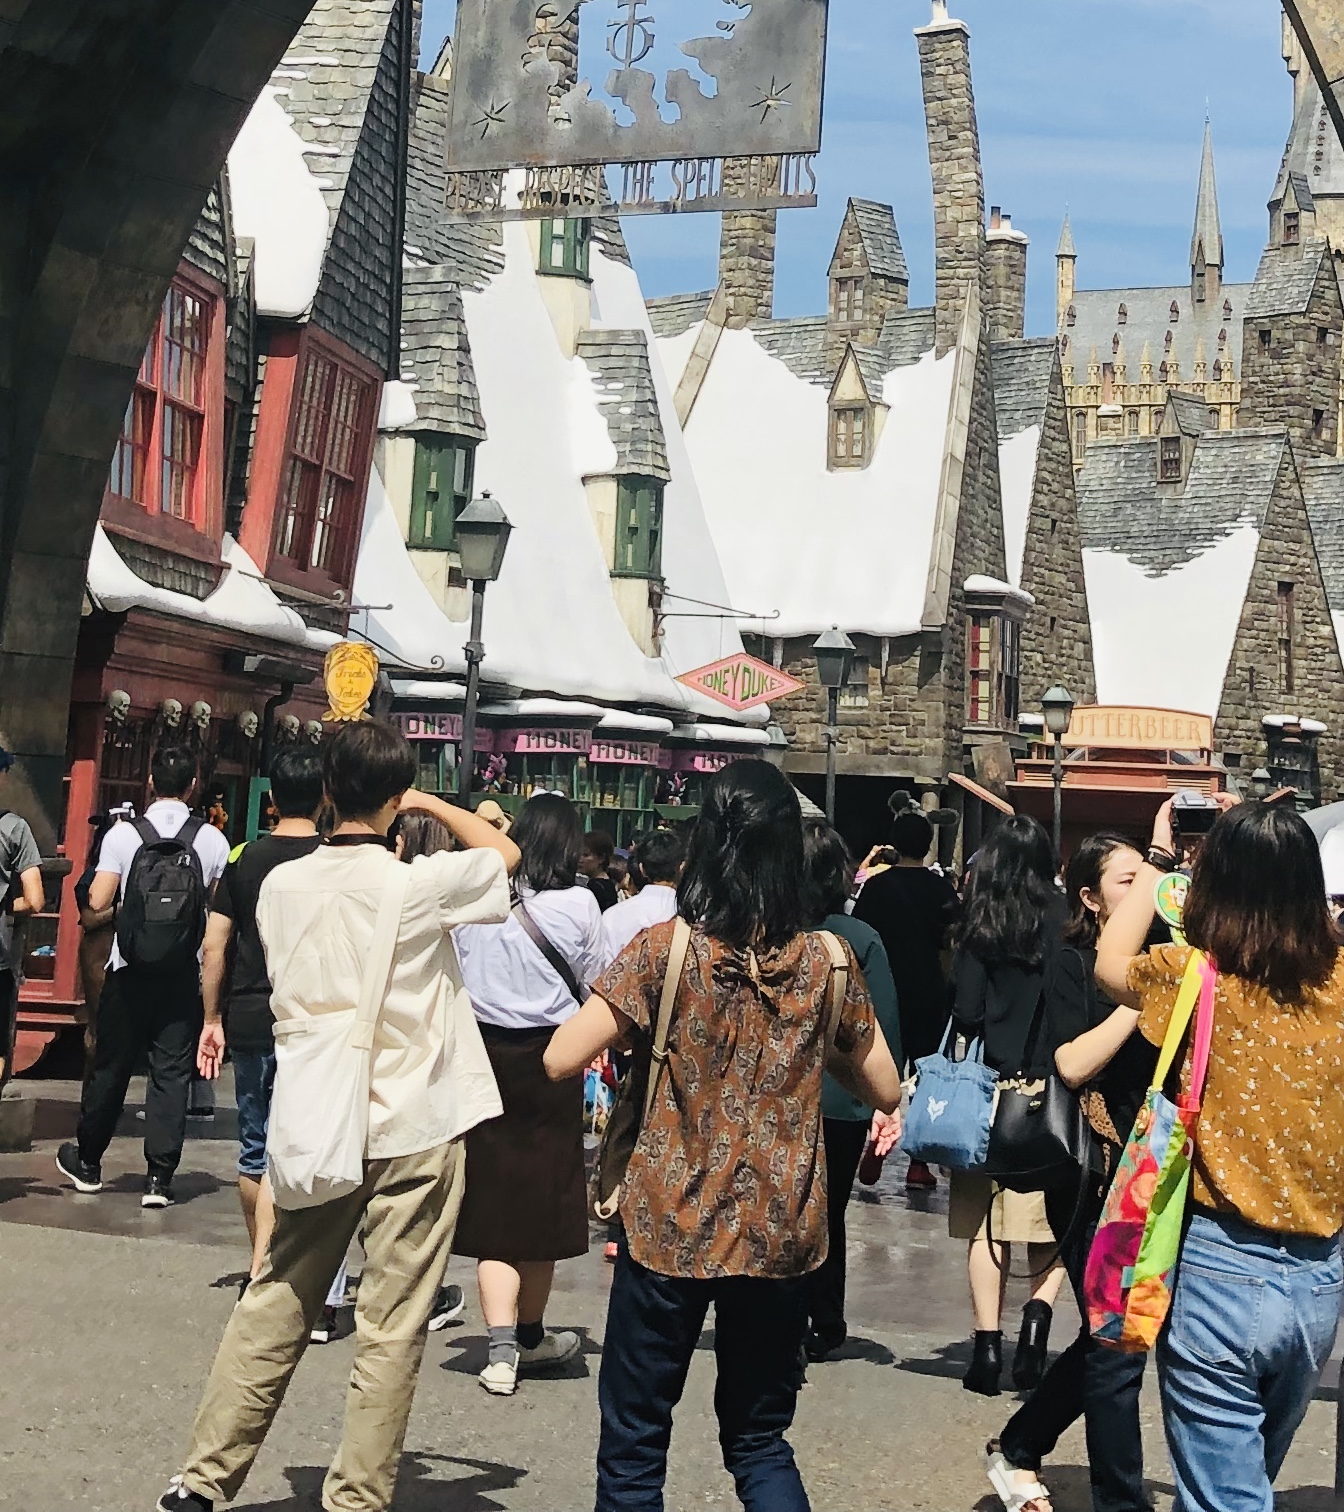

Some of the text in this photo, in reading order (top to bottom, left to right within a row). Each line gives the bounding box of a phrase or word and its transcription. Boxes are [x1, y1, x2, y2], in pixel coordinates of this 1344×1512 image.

[620, 161, 657, 205] THE
[671, 159, 729, 202] SPELL
[1069, 711, 1202, 744] UTTERBEER
